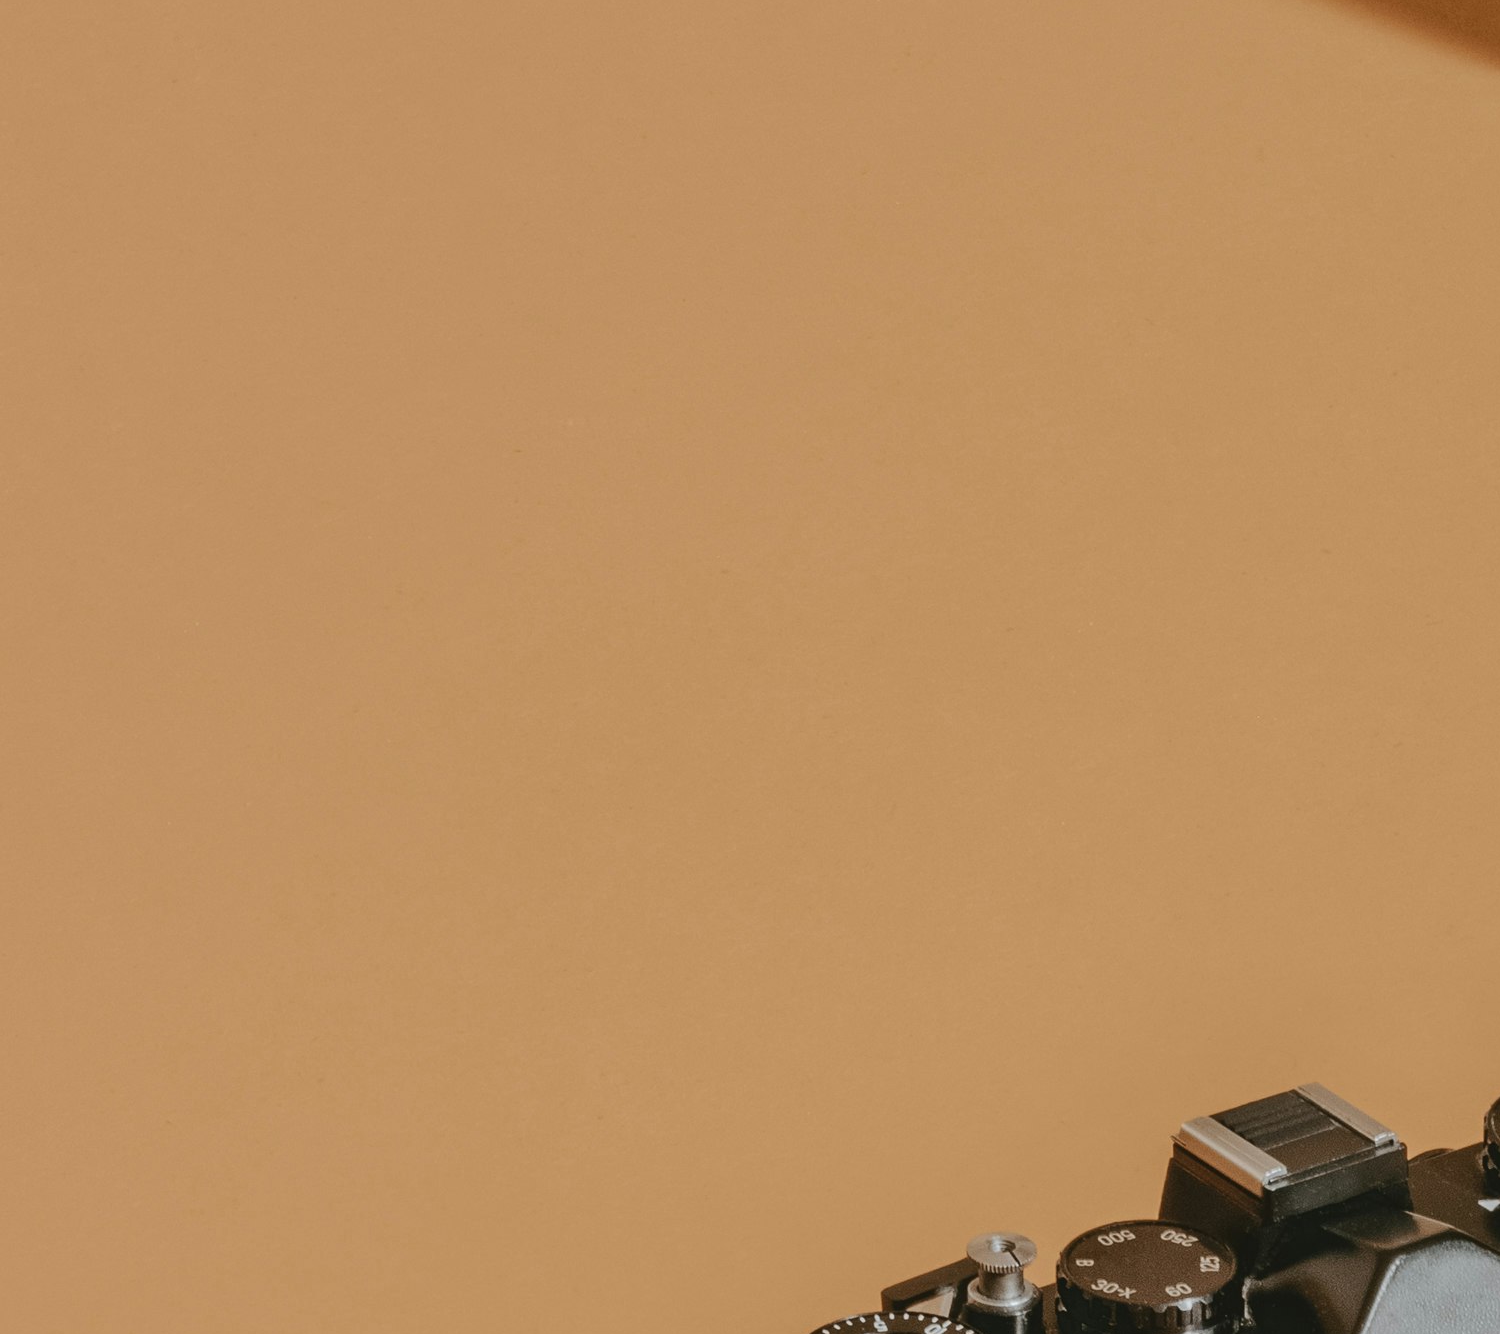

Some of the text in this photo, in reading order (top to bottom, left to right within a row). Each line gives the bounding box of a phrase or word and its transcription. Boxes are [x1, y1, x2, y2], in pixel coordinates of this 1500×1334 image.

[1098, 1230, 1136, 1246] 500
[1160, 1230, 1199, 1247] 250
[1076, 1259, 1095, 1269] B
[1200, 1255, 1220, 1272] 125
[1166, 1281, 1193, 1298] 60
